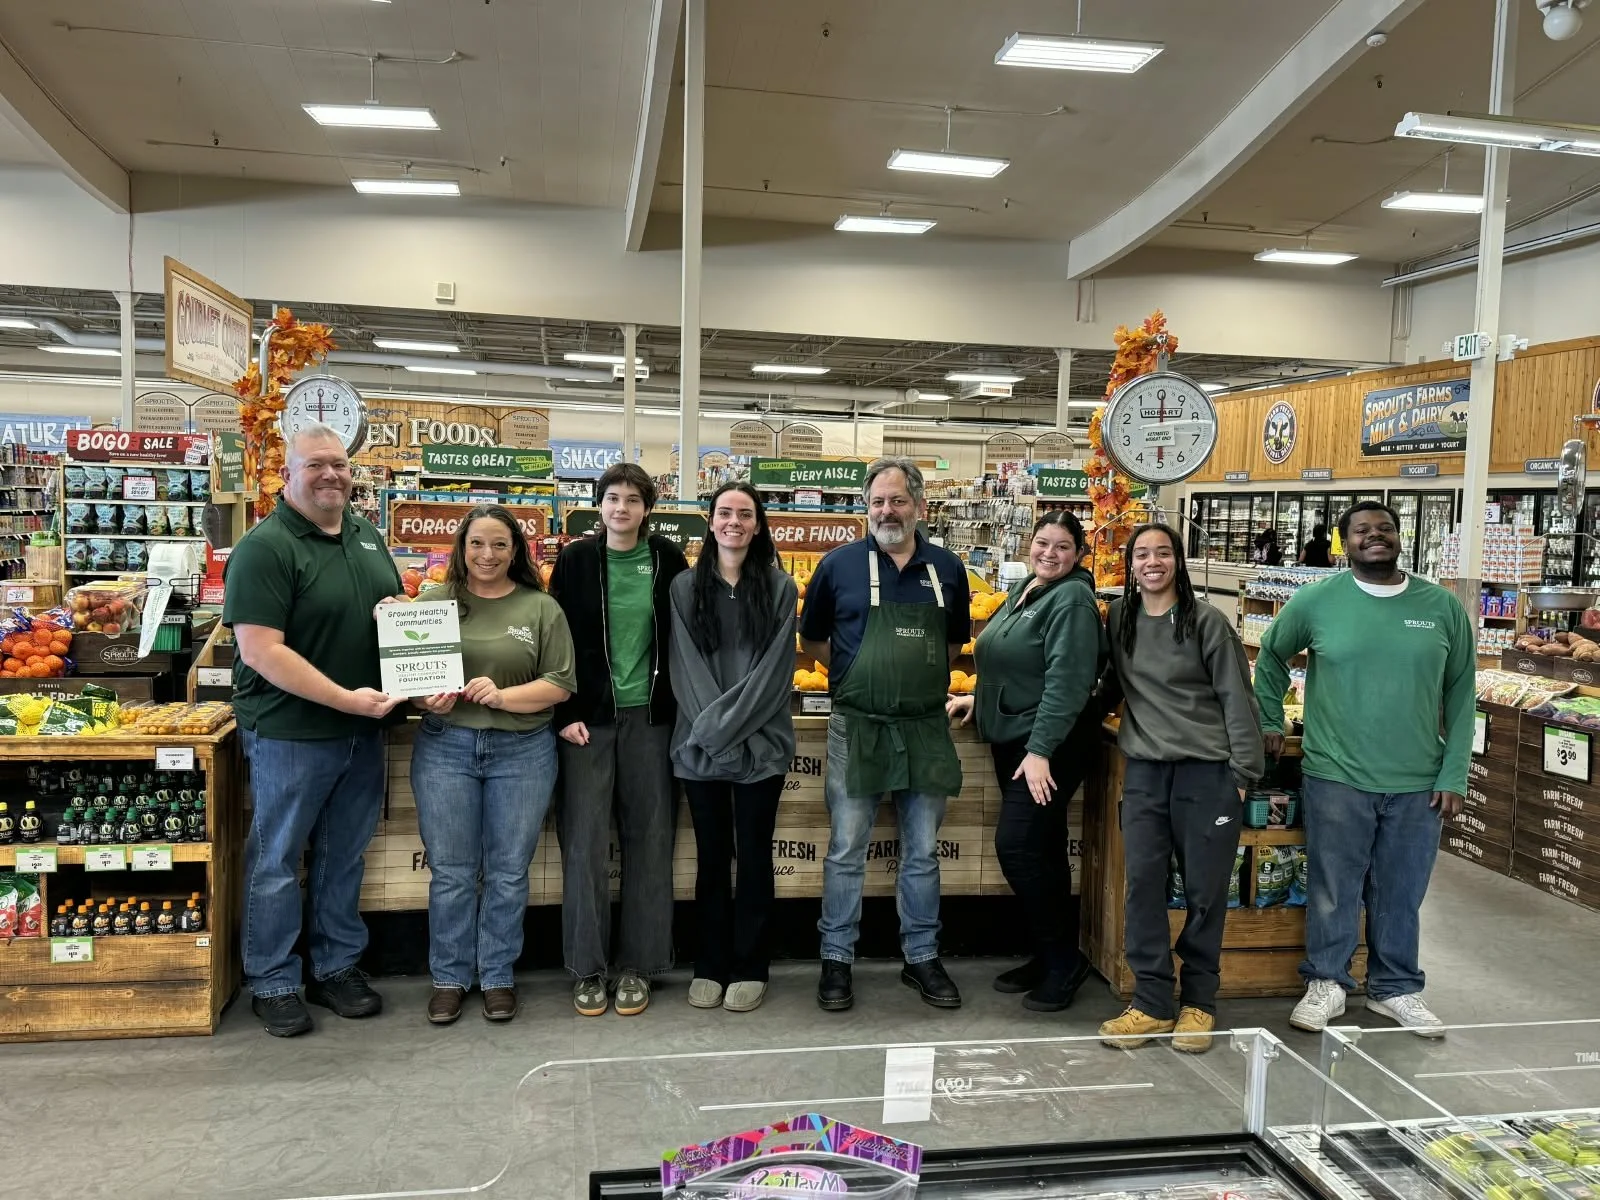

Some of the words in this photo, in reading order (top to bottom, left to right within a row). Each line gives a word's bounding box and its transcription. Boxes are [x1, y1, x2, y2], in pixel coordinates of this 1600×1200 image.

[1458, 335, 1478, 357] EXIT
[303, 392, 308, 402] 1
[317, 388, 325, 398] 0
[332, 393, 340, 403] 9
[1156, 389, 1166, 401] 0
[1138, 395, 1143, 406] 1
[1178, 395, 1186, 407] 9
[292, 406, 300, 416] 2
[343, 407, 350, 416] 8
[1364, 391, 1413, 427] SPROUTS
[1416, 386, 1453, 407] FARMS
[1122, 413, 1132, 425] 2
[1191, 412, 1200, 422] 8
[293, 424, 300, 433] 3
[343, 424, 351, 434] 7
[1369, 418, 1396, 447] MILK
[1398, 411, 1408, 433] &
[1411, 405, 1445, 429] DAIRY
[407, 417, 497, 449] FOODS
[77, 432, 130, 451] BOGO
[143, 437, 174, 450] SALE
[1122, 435, 1131, 446] 3
[1191, 434, 1200, 446] 7
[1441, 441, 1460, 449] YOGURT
[428, 453, 469, 466] TASTES
[472, 454, 513, 467] GREAT
[560, 446, 623, 470] SNACKS
[1135, 452, 1144, 464] 4
[1176, 451, 1185, 462] 6
[1156, 457, 1164, 469] 5
[1529, 462, 1553, 470] ORGANIC
[790, 470, 823, 481] EVERY
[824, 467, 858, 480] AISLE
[1408, 466, 1428, 474] YOGURT
[1042, 477, 1077, 488] TASTES
[1079, 477, 1109, 488] GEA
[401, 518, 461, 535] FORAG
[659, 522, 679, 532] New
[809, 525, 856, 542] FINDS
[388, 610, 418, 618] Growing
[419, 608, 449, 617] Healthy
[395, 618, 443, 627] Communities
[1404, 619, 1435, 627] SPROUTS
[103, 650, 138, 660] SPROUTS
[395, 660, 447, 673] SPROUTS
[398, 675, 446, 683] FOUNDATION
[1543, 789, 1584, 810] FARM-FRESH
[1543, 818, 1585, 840] FARM-FRESH
[1449, 837, 1484, 858] FARM-FRESH
[1541, 847, 1582, 870] FARM-FRESH
[1264, 862, 1272, 871] 5
[1539, 872, 1579, 897] FARM-FRESH
